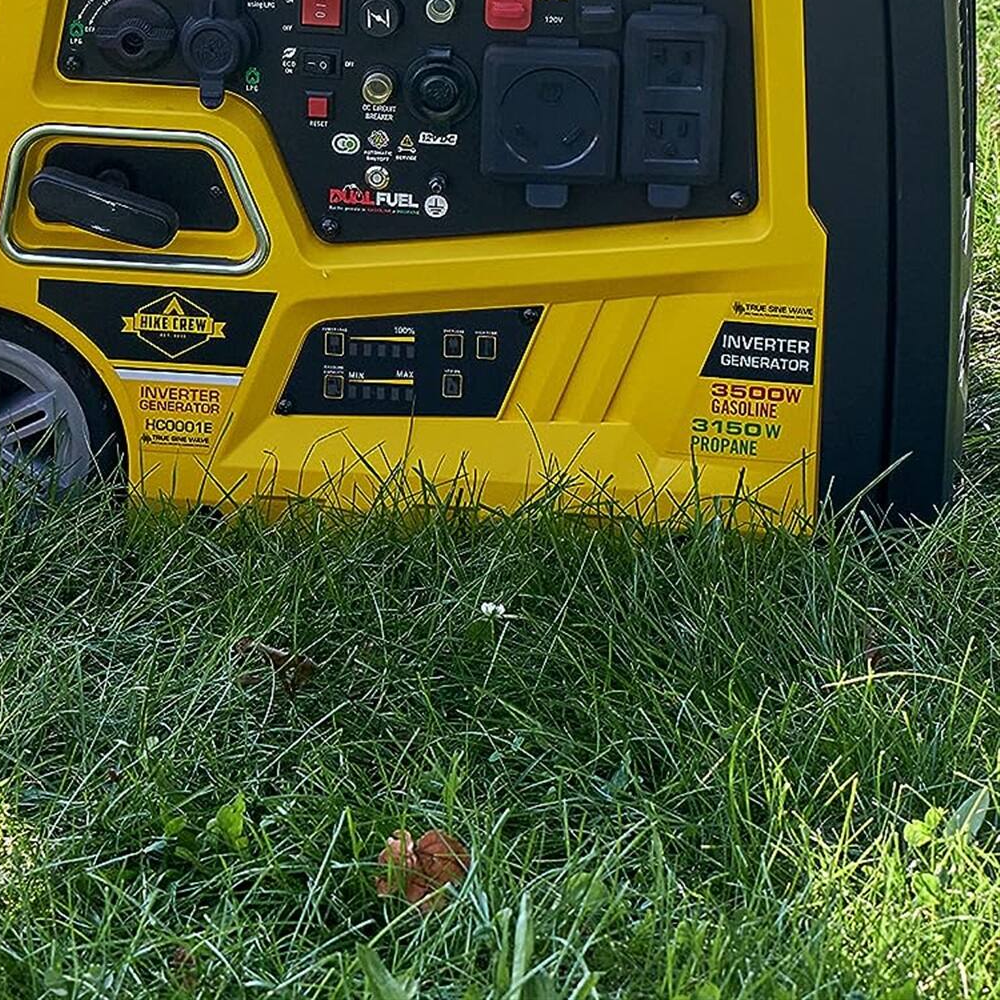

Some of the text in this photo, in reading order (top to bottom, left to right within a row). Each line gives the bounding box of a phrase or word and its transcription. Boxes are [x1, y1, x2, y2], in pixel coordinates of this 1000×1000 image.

[140, 315, 207, 332] HIKE CREW
[722, 334, 810, 354] INVERTER
[720, 354, 810, 372] GENERATOR
[140, 386, 221, 403] INVERTER
[711, 383, 801, 403] 3500W
[139, 400, 221, 415] GENERATOR
[711, 399, 778, 418] GASOLINE
[691, 435, 758, 455] PROPANE
